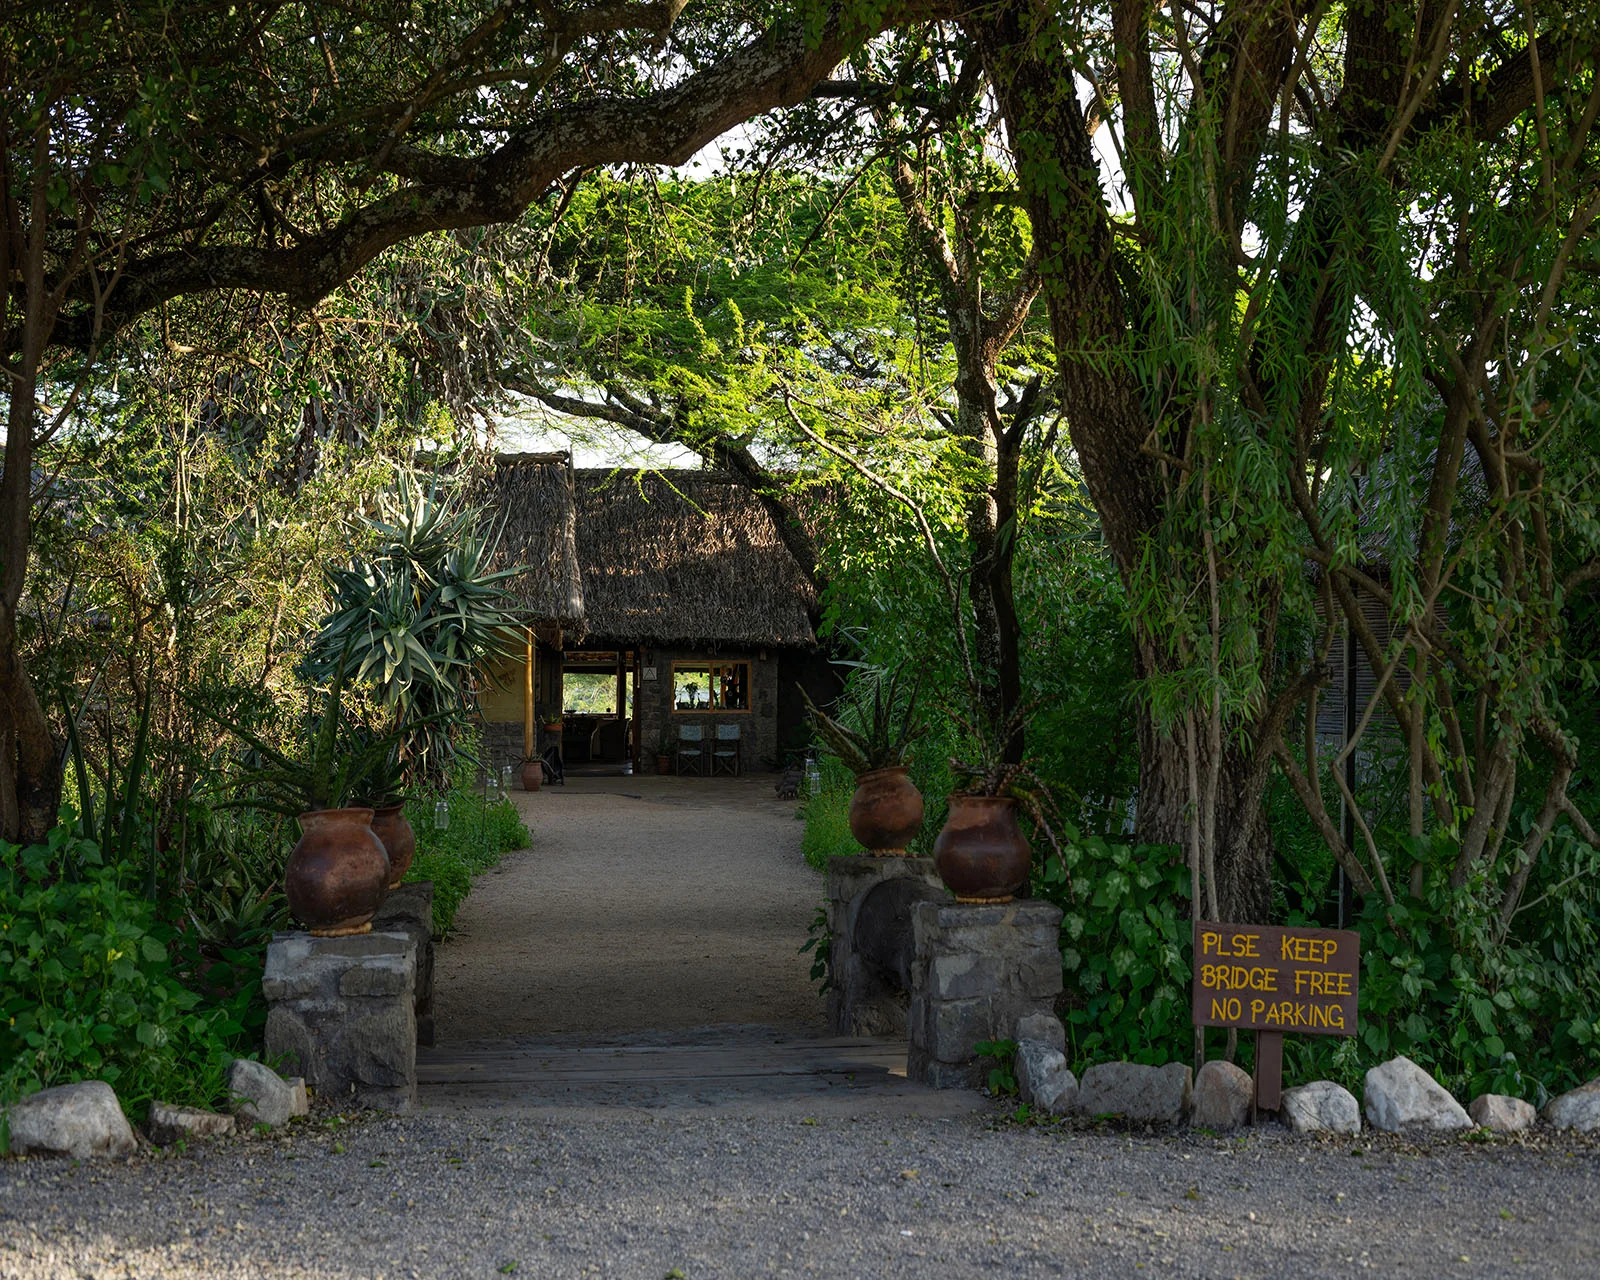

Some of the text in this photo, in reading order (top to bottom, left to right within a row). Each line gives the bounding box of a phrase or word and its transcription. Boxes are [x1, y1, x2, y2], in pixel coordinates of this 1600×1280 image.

[1202, 932, 1337, 964] PLSE KEEP
[1201, 965, 1352, 995] BRIDGE FREE
[1211, 998, 1344, 1029] NO PARKING
